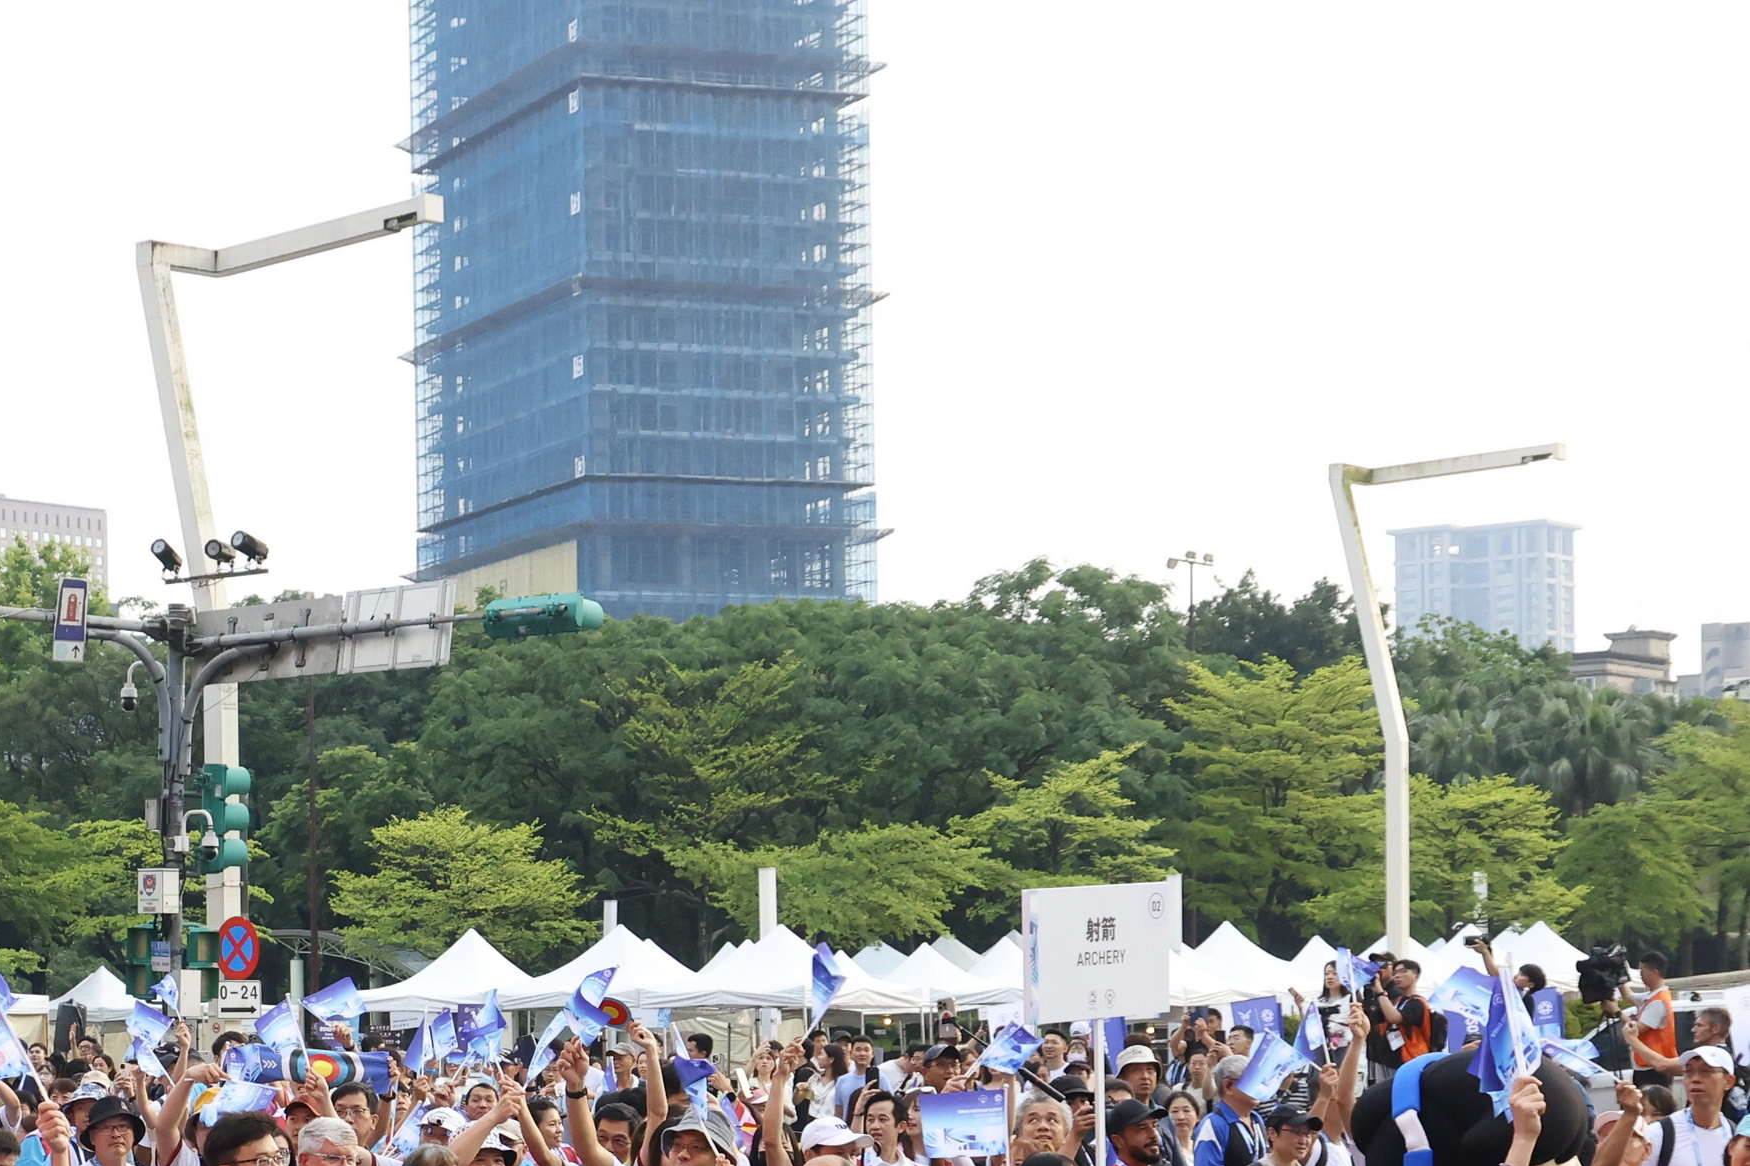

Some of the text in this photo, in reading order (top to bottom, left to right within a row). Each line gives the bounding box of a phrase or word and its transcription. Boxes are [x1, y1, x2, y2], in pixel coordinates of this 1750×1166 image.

[1151, 900, 1162, 912] 02
[1086, 916, 1117, 943] 射箭
[1076, 949, 1126, 967] ARCHERY
[219, 985, 258, 1000] 0-24
